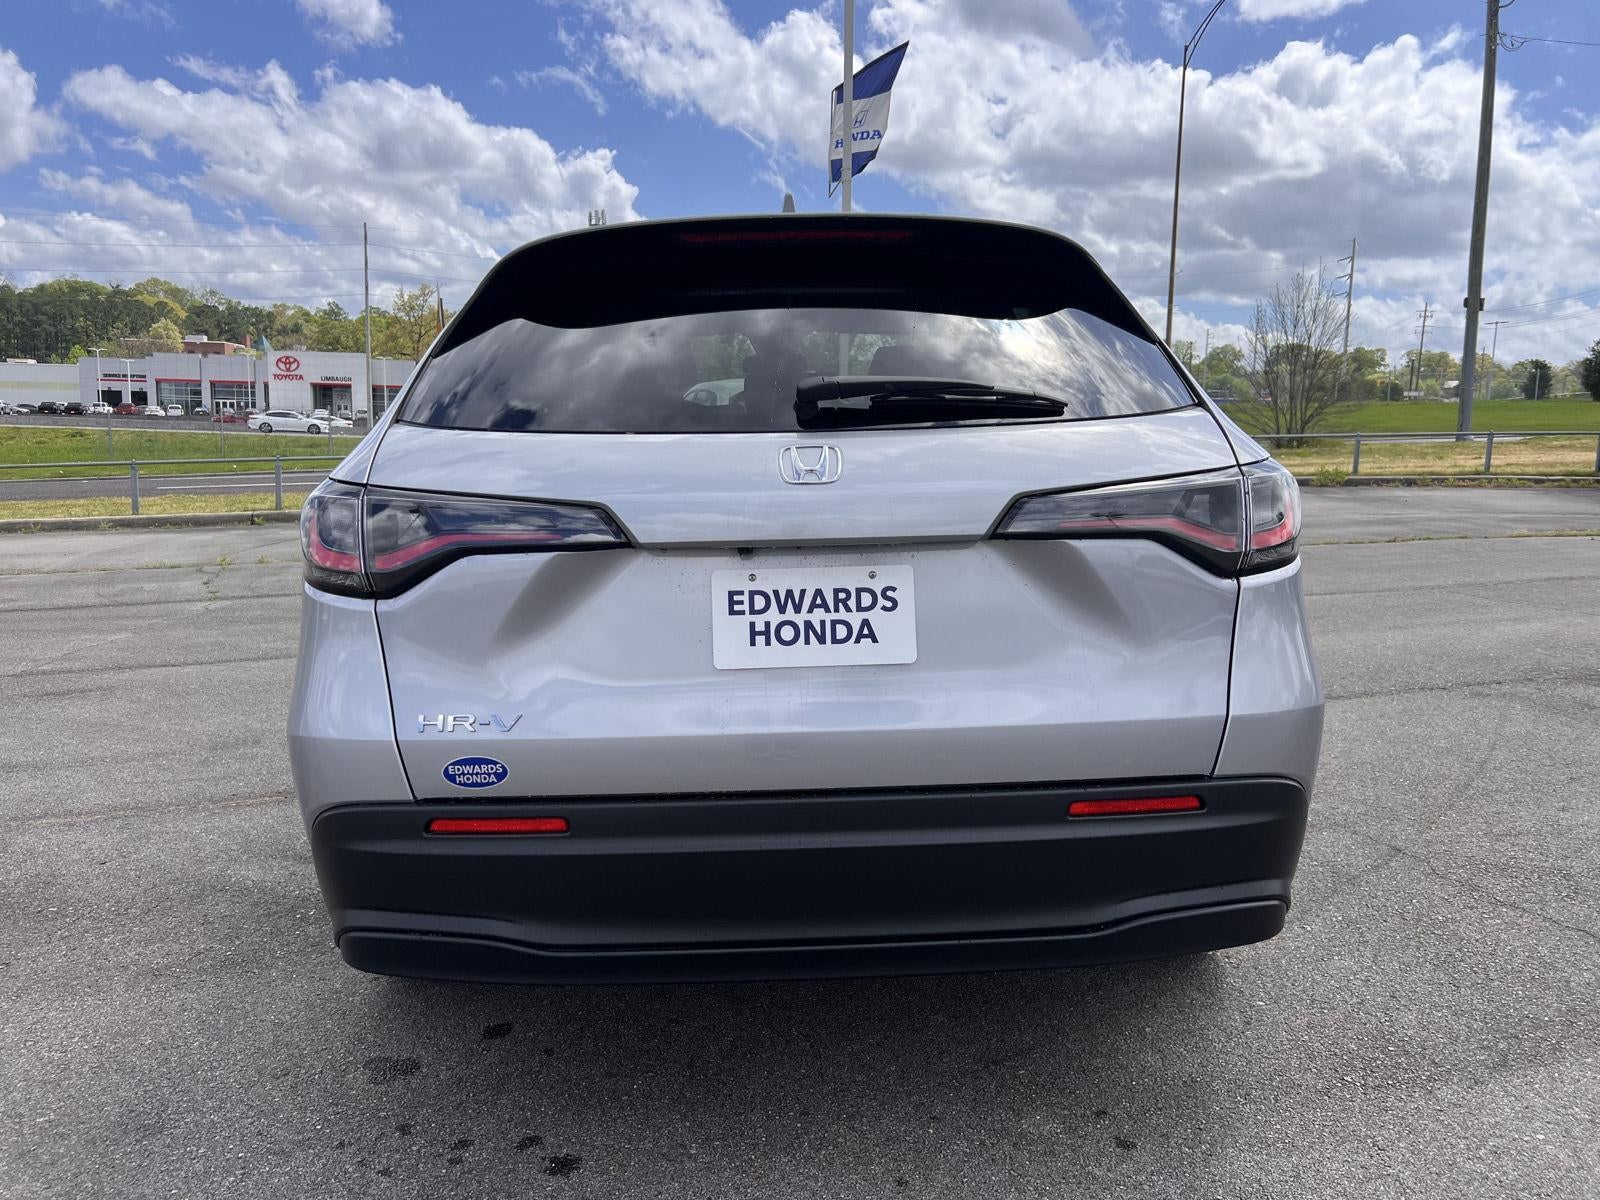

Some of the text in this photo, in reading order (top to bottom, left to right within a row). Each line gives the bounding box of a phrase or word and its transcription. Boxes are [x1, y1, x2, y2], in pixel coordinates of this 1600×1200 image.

[834, 129, 882, 149] HNDA
[727, 585, 899, 616] EDWARDS
[749, 618, 879, 647] HONDA
[417, 713, 523, 733] HR-V
[448, 763, 503, 775] EDWARDS
[455, 774, 498, 784] HONDA
